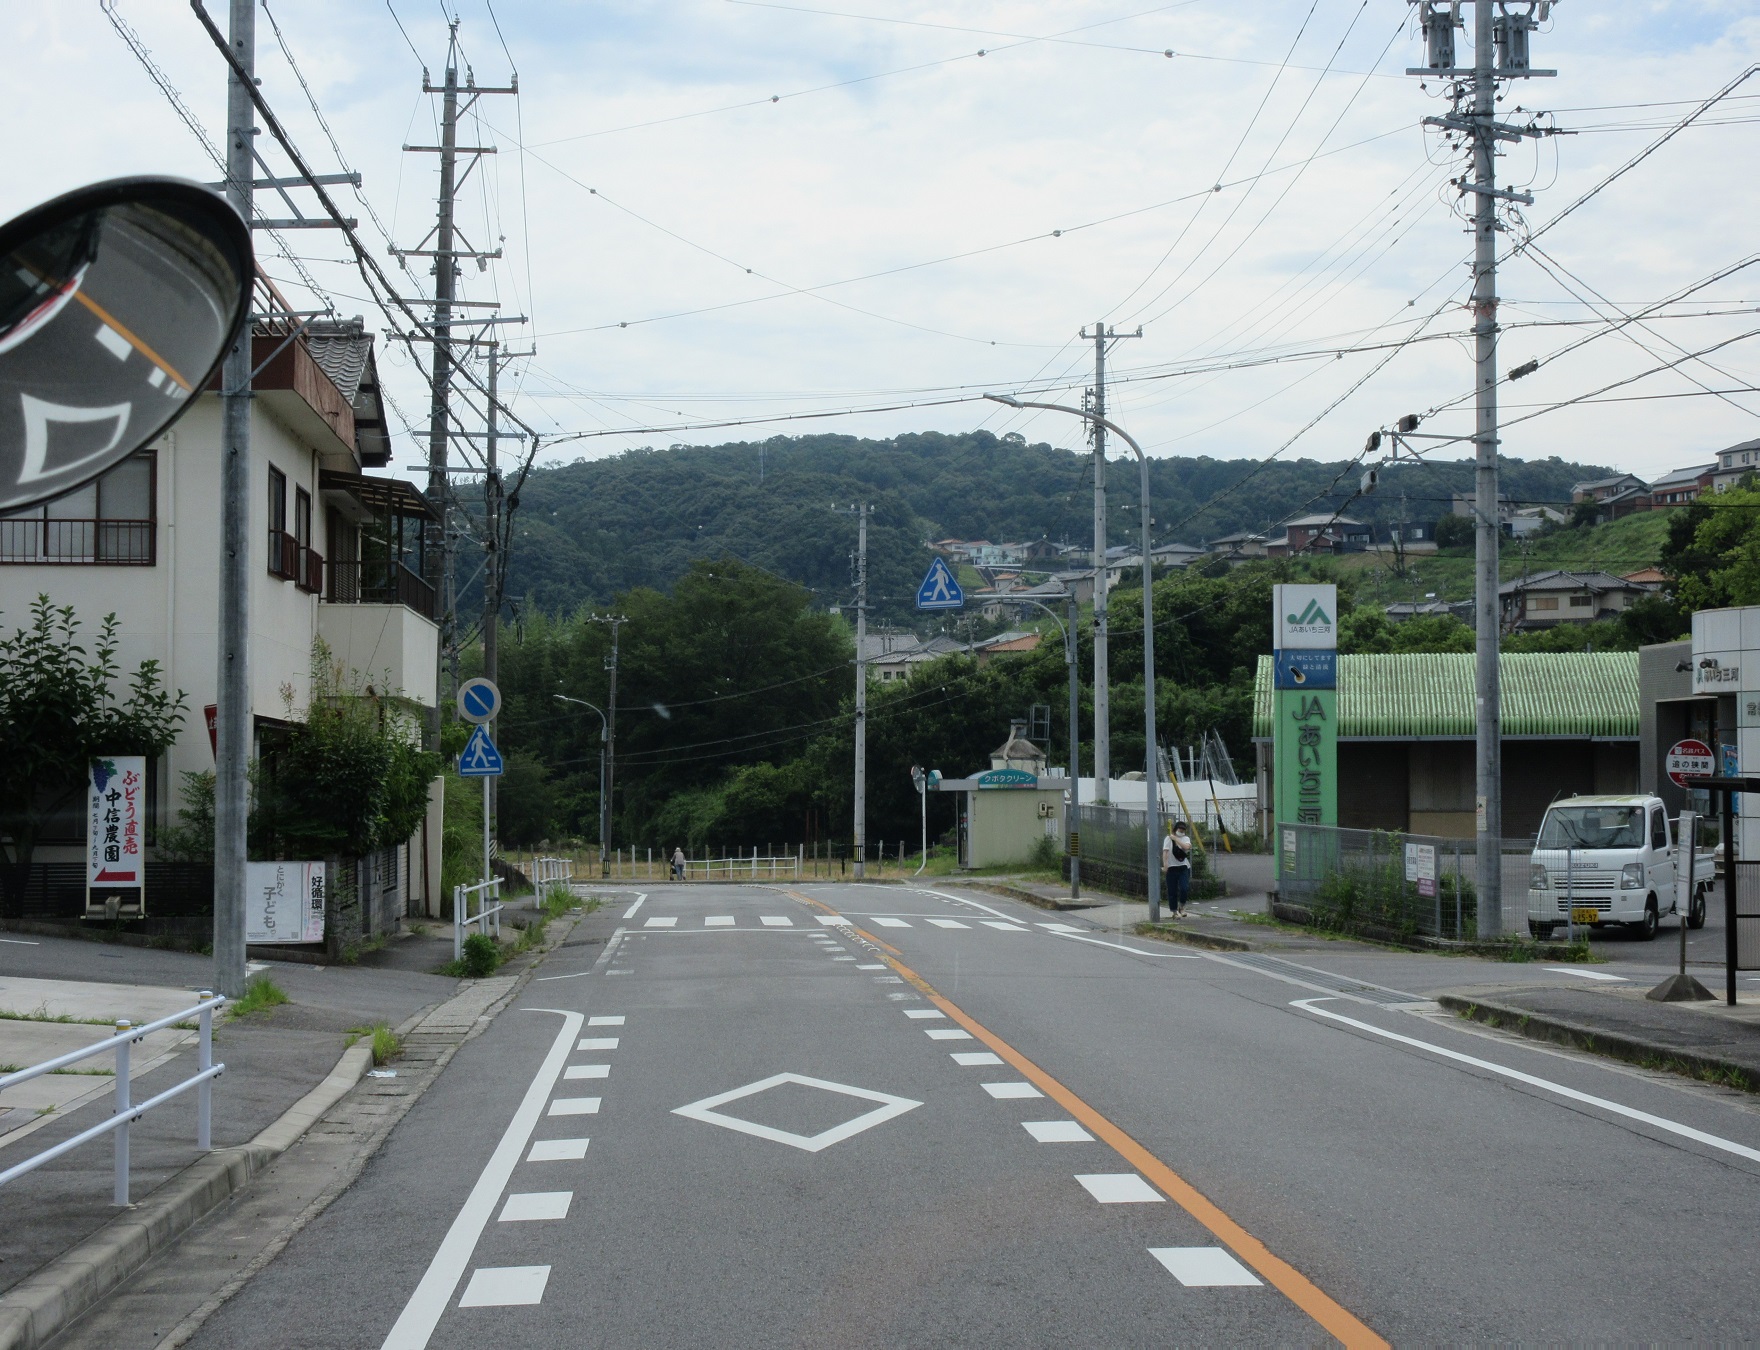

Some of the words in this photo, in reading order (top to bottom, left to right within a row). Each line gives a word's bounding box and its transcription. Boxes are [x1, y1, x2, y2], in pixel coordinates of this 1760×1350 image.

[984, 774, 1032, 783] クボタクリーン
[103, 787, 122, 862] 中信農園
[122, 770, 140, 855] ぶどう直売
[277, 866, 285, 897] とにかく
[311, 876, 323, 909] 好循環
